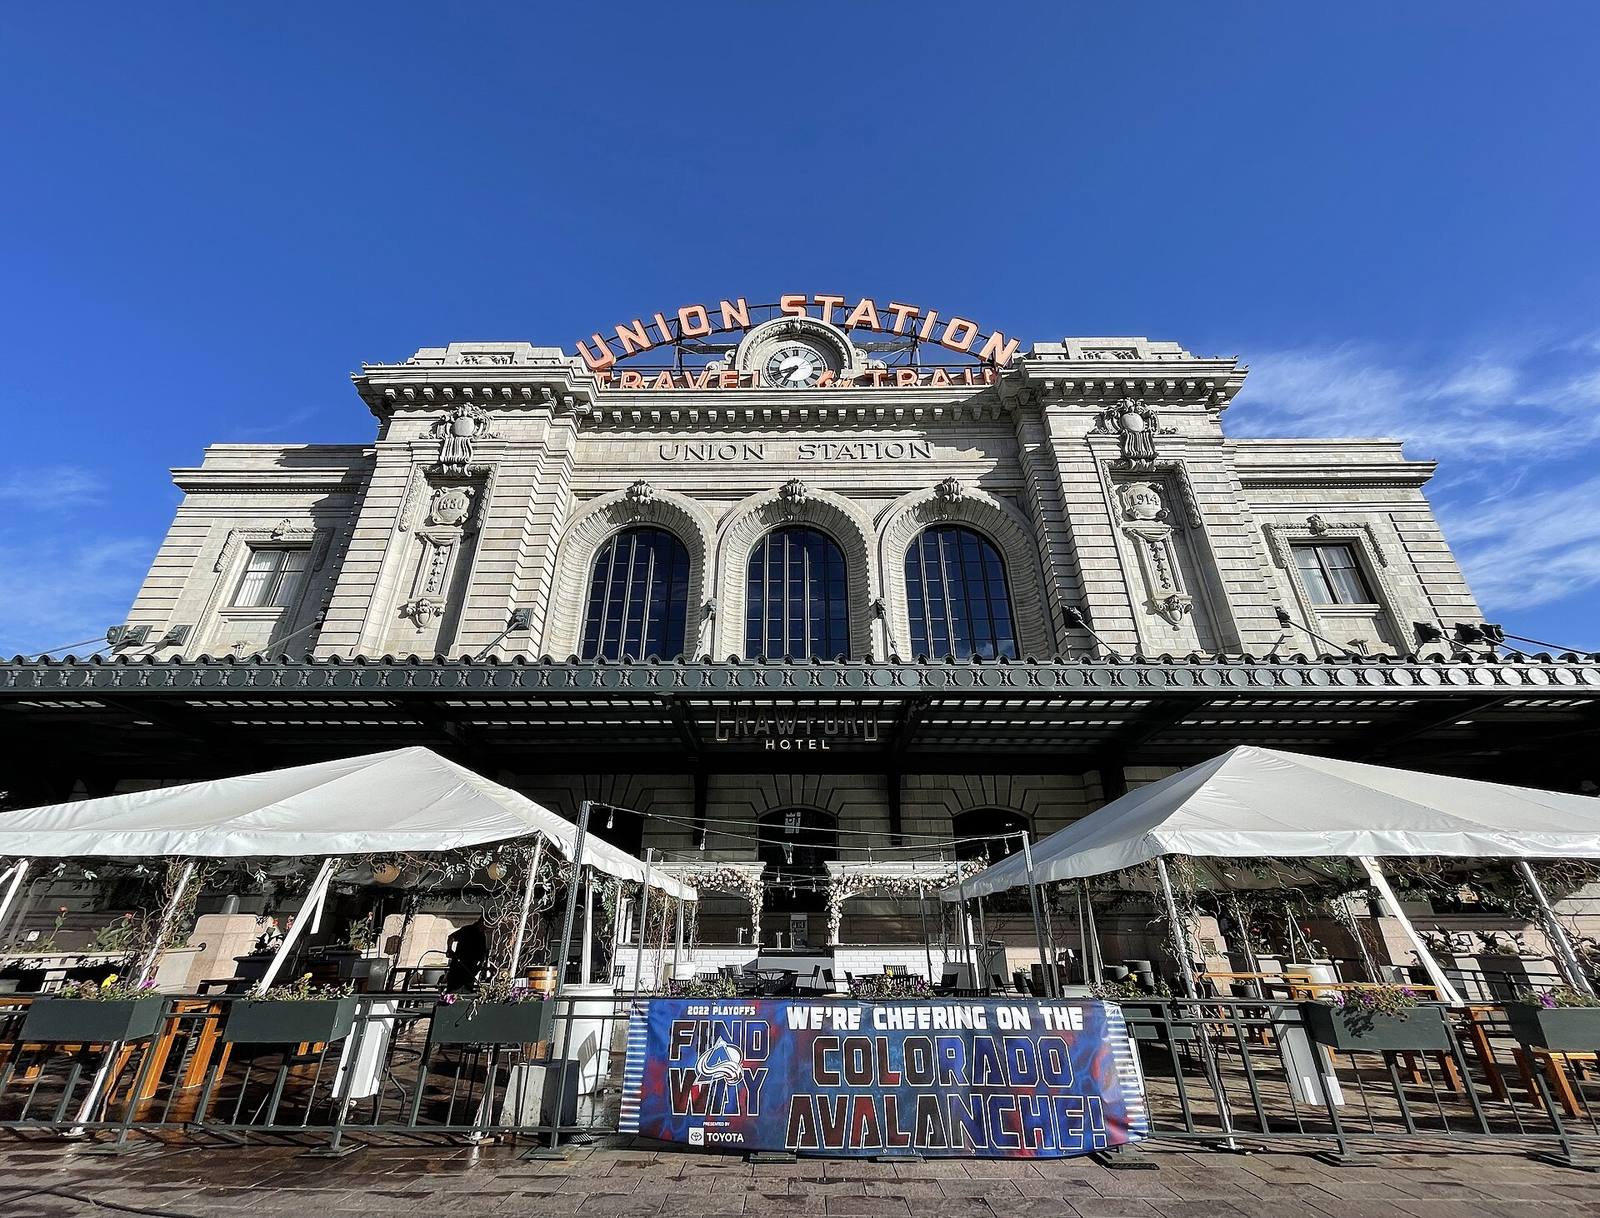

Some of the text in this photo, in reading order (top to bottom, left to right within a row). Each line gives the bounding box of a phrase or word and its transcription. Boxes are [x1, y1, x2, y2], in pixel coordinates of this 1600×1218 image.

[575, 297, 751, 371] UNION
[780, 294, 1021, 367] STATION
[658, 442, 933, 461] UNION STATION
[716, 707, 878, 741] CRAWFORD
[765, 740, 830, 750] HOTEL
[687, 1006, 756, 1016] 2022 PLAYOFFS
[786, 1006, 1084, 1031] WE'RE CHEERING ON THE
[669, 1019, 770, 1061] FIND
[812, 1035, 1074, 1088] COLORADO
[668, 1067, 769, 1117] WAY
[706, 1132, 744, 1142] TOYOTA
[784, 1094, 1108, 1150] AVALANCHE!
